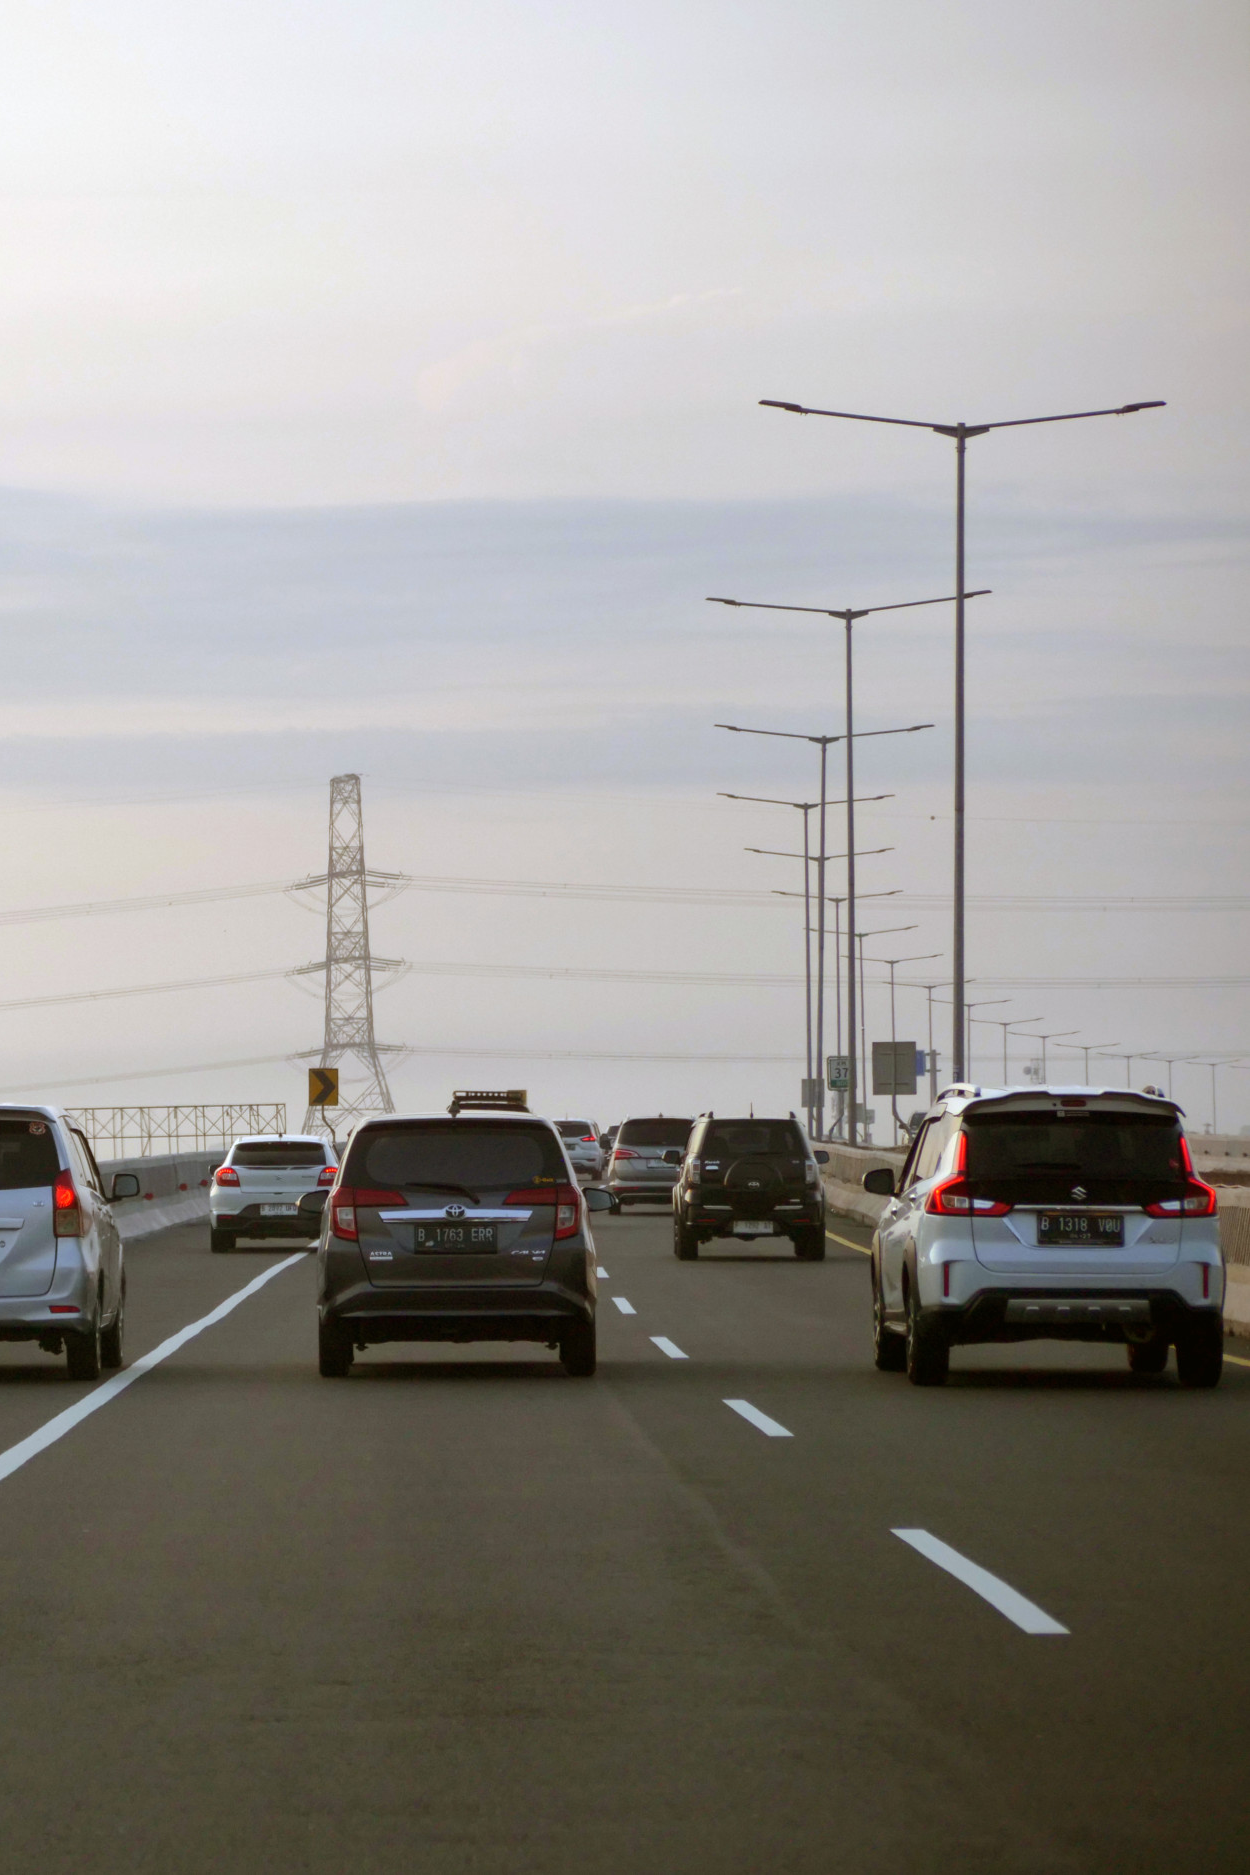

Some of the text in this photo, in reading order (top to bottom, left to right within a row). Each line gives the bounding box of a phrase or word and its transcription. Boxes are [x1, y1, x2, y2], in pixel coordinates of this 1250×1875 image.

[834, 1067, 848, 1078] 37
[1041, 1217, 1049, 1230] B
[1059, 1217, 1088, 1232] 1318
[418, 1229, 493, 1241] B 1763 ERR
